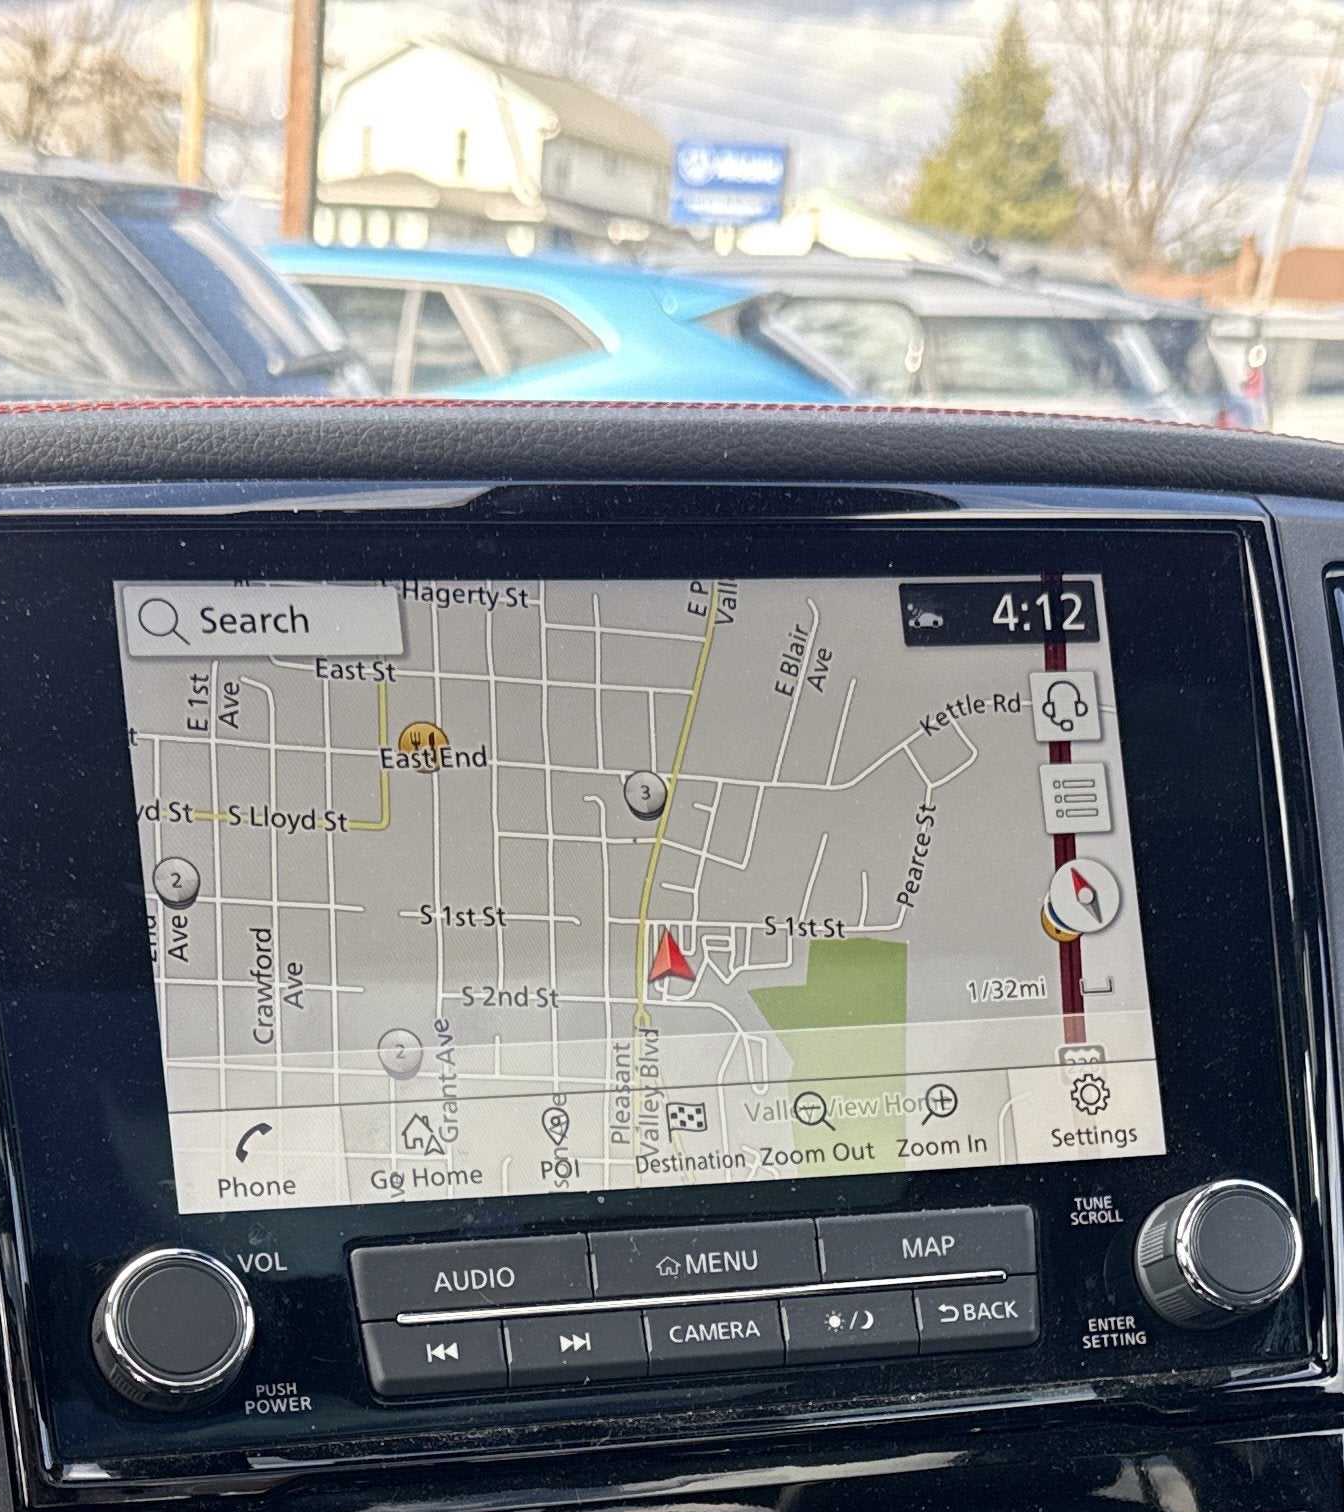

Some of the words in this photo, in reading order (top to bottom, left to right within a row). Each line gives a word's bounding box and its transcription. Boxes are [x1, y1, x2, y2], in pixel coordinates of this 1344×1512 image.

[402, 581, 500, 609] Hagerty
[506, 588, 529, 609] St
[199, 604, 310, 635] Search
[688, 602, 707, 617] E
[992, 592, 1086, 633] 4:12
[779, 623, 810, 679] Blair
[315, 657, 366, 681] East
[372, 661, 397, 682] St
[805, 647, 834, 693] Ave
[188, 673, 210, 710] 1st
[775, 682, 796, 698] E
[218, 681, 240, 729] Ave
[918, 695, 987, 737] Kettle
[992, 692, 1022, 715] Rd
[188, 715, 209, 732] E
[380, 746, 433, 770] East
[441, 745, 488, 769] End
[168, 801, 194, 823] St
[228, 805, 242, 826] S
[249, 804, 317, 834] Lloyd
[324, 810, 349, 833] St
[896, 831, 932, 908] Pearce
[918, 803, 937, 828] St
[420, 905, 433, 926] S
[442, 906, 477, 927] 1st
[483, 907, 507, 928] St
[764, 916, 777, 936] S
[784, 916, 817, 937] 1st
[822, 918, 846, 938] St
[167, 914, 189, 963] Ave
[249, 926, 275, 1045] Crawford
[282, 960, 305, 1010] Ave
[461, 986, 475, 1007] S
[483, 985, 529, 1007] 2nd
[534, 987, 560, 1009] St
[967, 978, 1047, 1001] 1/32mi
[433, 1018, 457, 1066] Ave
[638, 1027, 660, 1079] Blvd
[610, 1041, 632, 1145] Pleasant
[438, 1071, 460, 1144] Grant
[825, 1095, 878, 1118] View
[638, 1085, 660, 1157] Valley
[896, 1135, 961, 1158] Zoom
[962, 1133, 988, 1154] In
[1051, 1124, 1139, 1150] Settings
[635, 1149, 747, 1175] Destination
[759, 1145, 826, 1167] Zoom
[832, 1141, 876, 1162] Out
[370, 1169, 405, 1190] Go
[412, 1167, 484, 1188] Home
[539, 1158, 581, 1180] POI
[217, 1177, 297, 1199] Phone
[1073, 1196, 1114, 1212] TUNE
[1070, 1208, 1125, 1226] SCROLL
[902, 1235, 956, 1260] MAP
[236, 1252, 289, 1275] VOL
[684, 1249, 759, 1276] MENU
[433, 1266, 516, 1293] AUDIO
[962, 1299, 1019, 1323] BACK
[668, 1320, 761, 1345] CAMERA
[1087, 1315, 1137, 1334] ENTER
[1081, 1330, 1148, 1350] SETTING
[255, 1382, 298, 1398] PUSH
[244, 1396, 313, 1415] POWER
